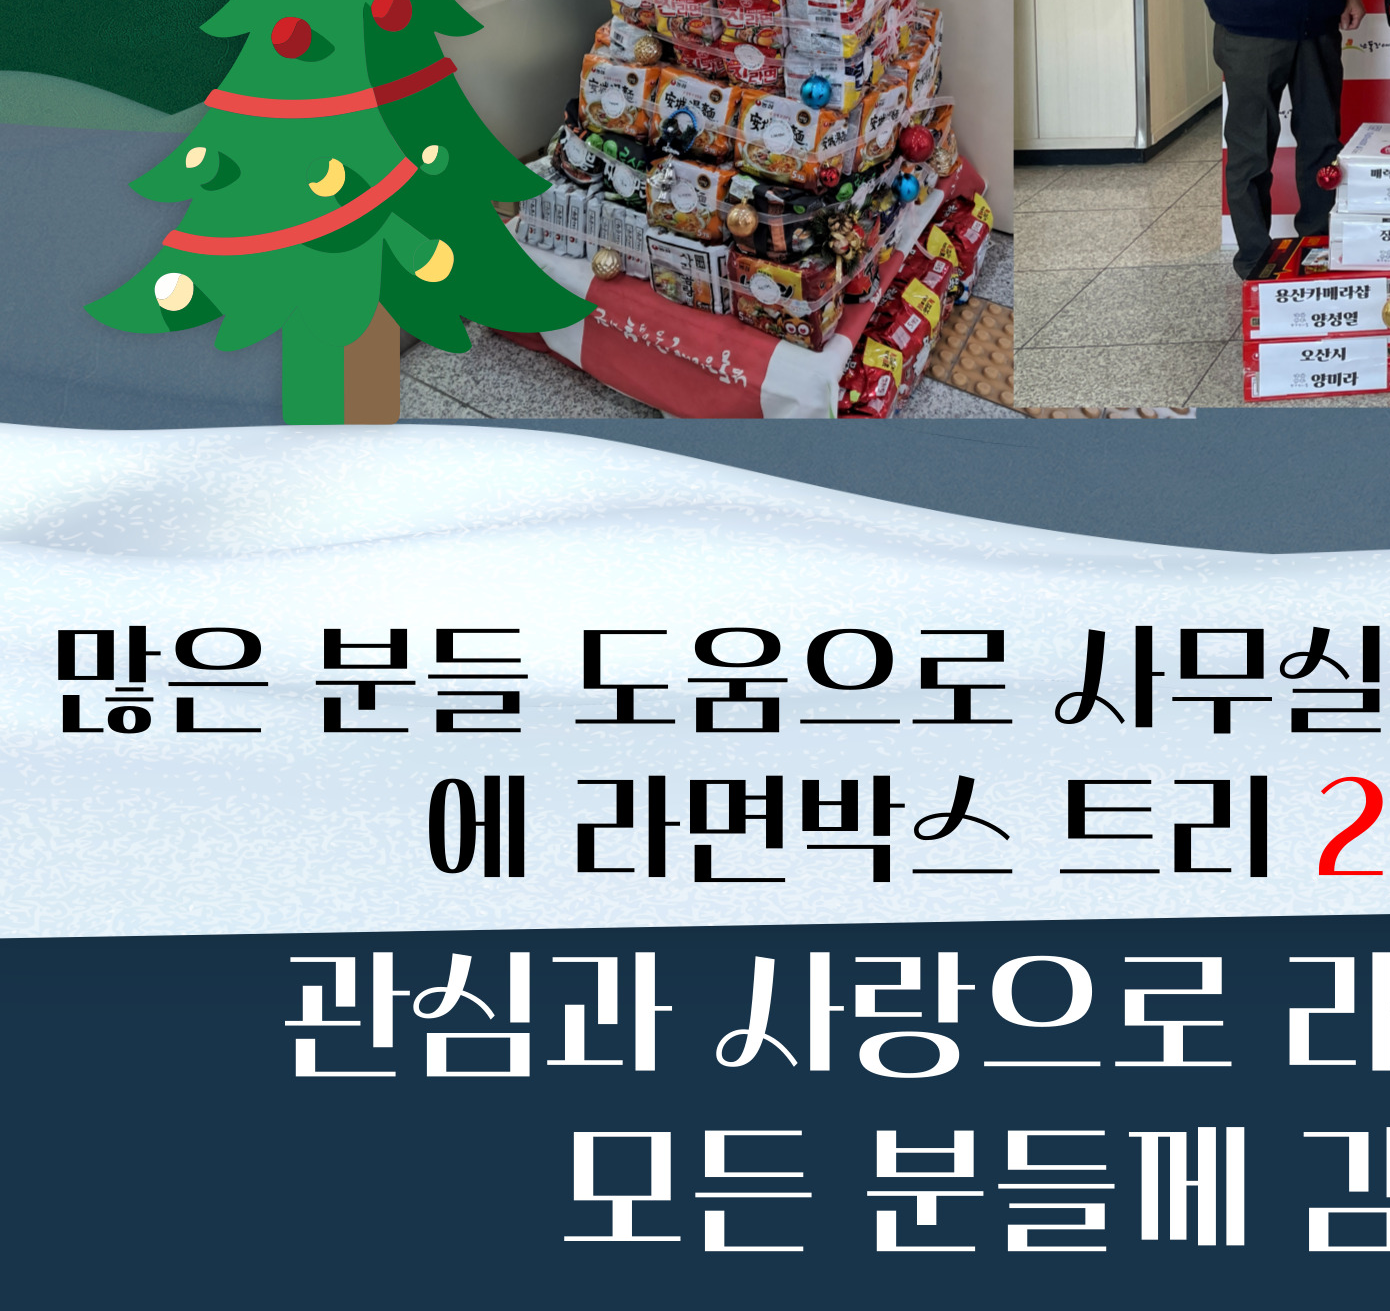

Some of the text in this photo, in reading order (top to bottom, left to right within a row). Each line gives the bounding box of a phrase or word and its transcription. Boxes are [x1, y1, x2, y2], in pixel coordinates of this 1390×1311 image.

[1276, 284, 1370, 303] 용산카메라샵
[1311, 310, 1358, 328] 양성열
[1301, 346, 1347, 363] 오산시
[1310, 371, 1358, 388] 양미라
